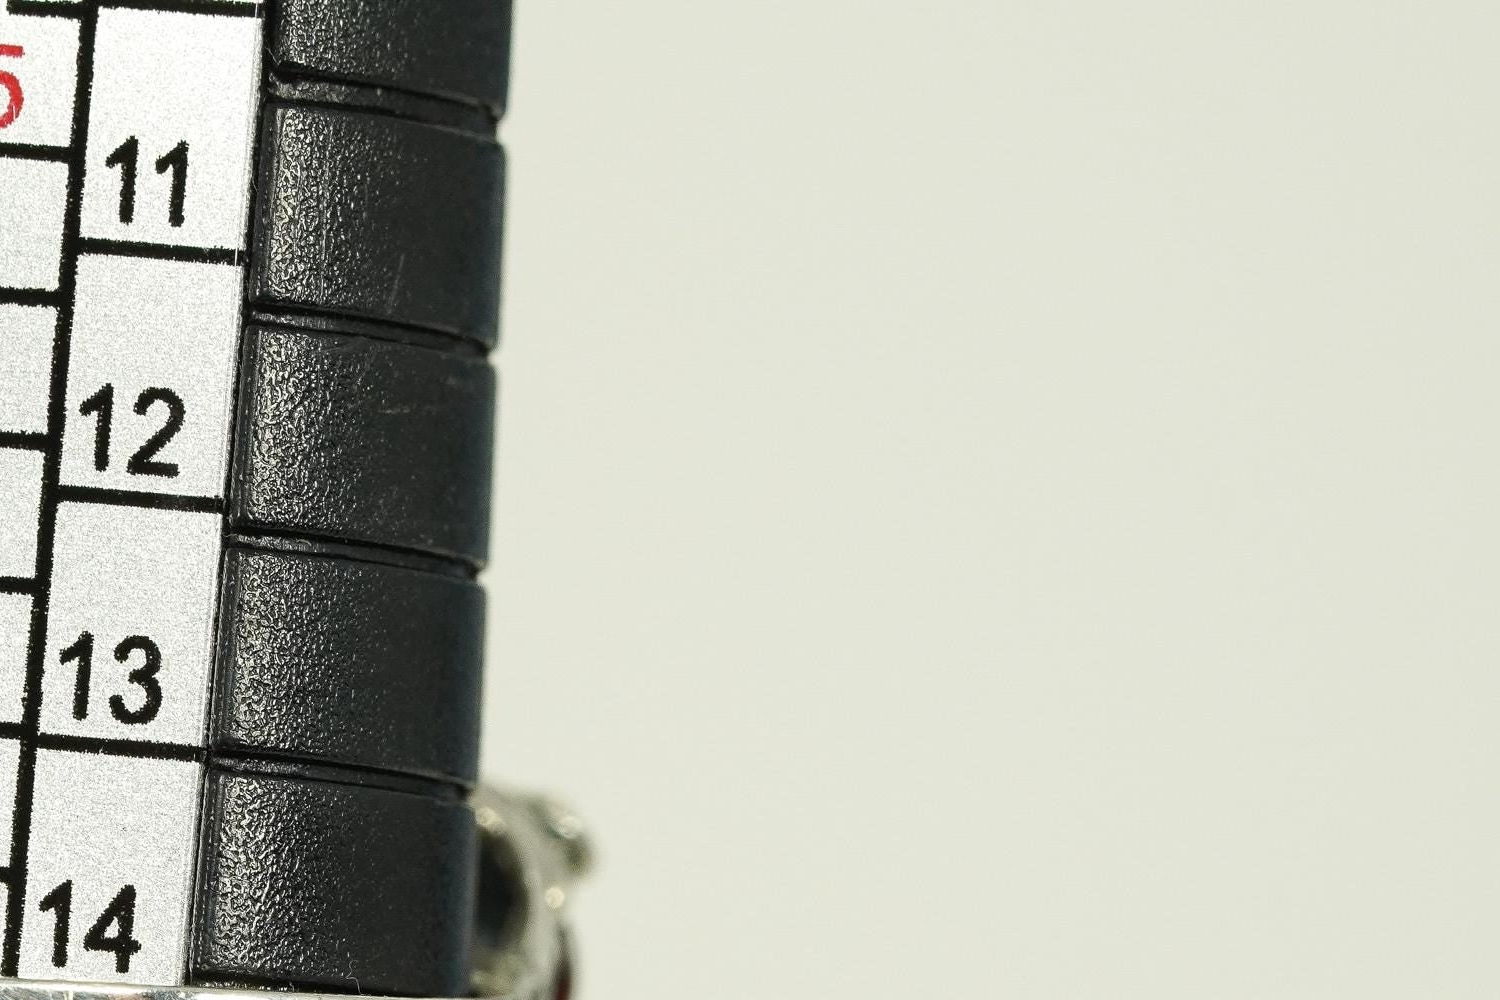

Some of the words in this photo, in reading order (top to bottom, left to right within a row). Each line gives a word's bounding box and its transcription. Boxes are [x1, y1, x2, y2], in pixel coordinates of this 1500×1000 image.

[105, 135, 190, 228] 11
[78, 382, 187, 479] 12
[58, 630, 164, 726] 13
[38, 879, 142, 974] 14
